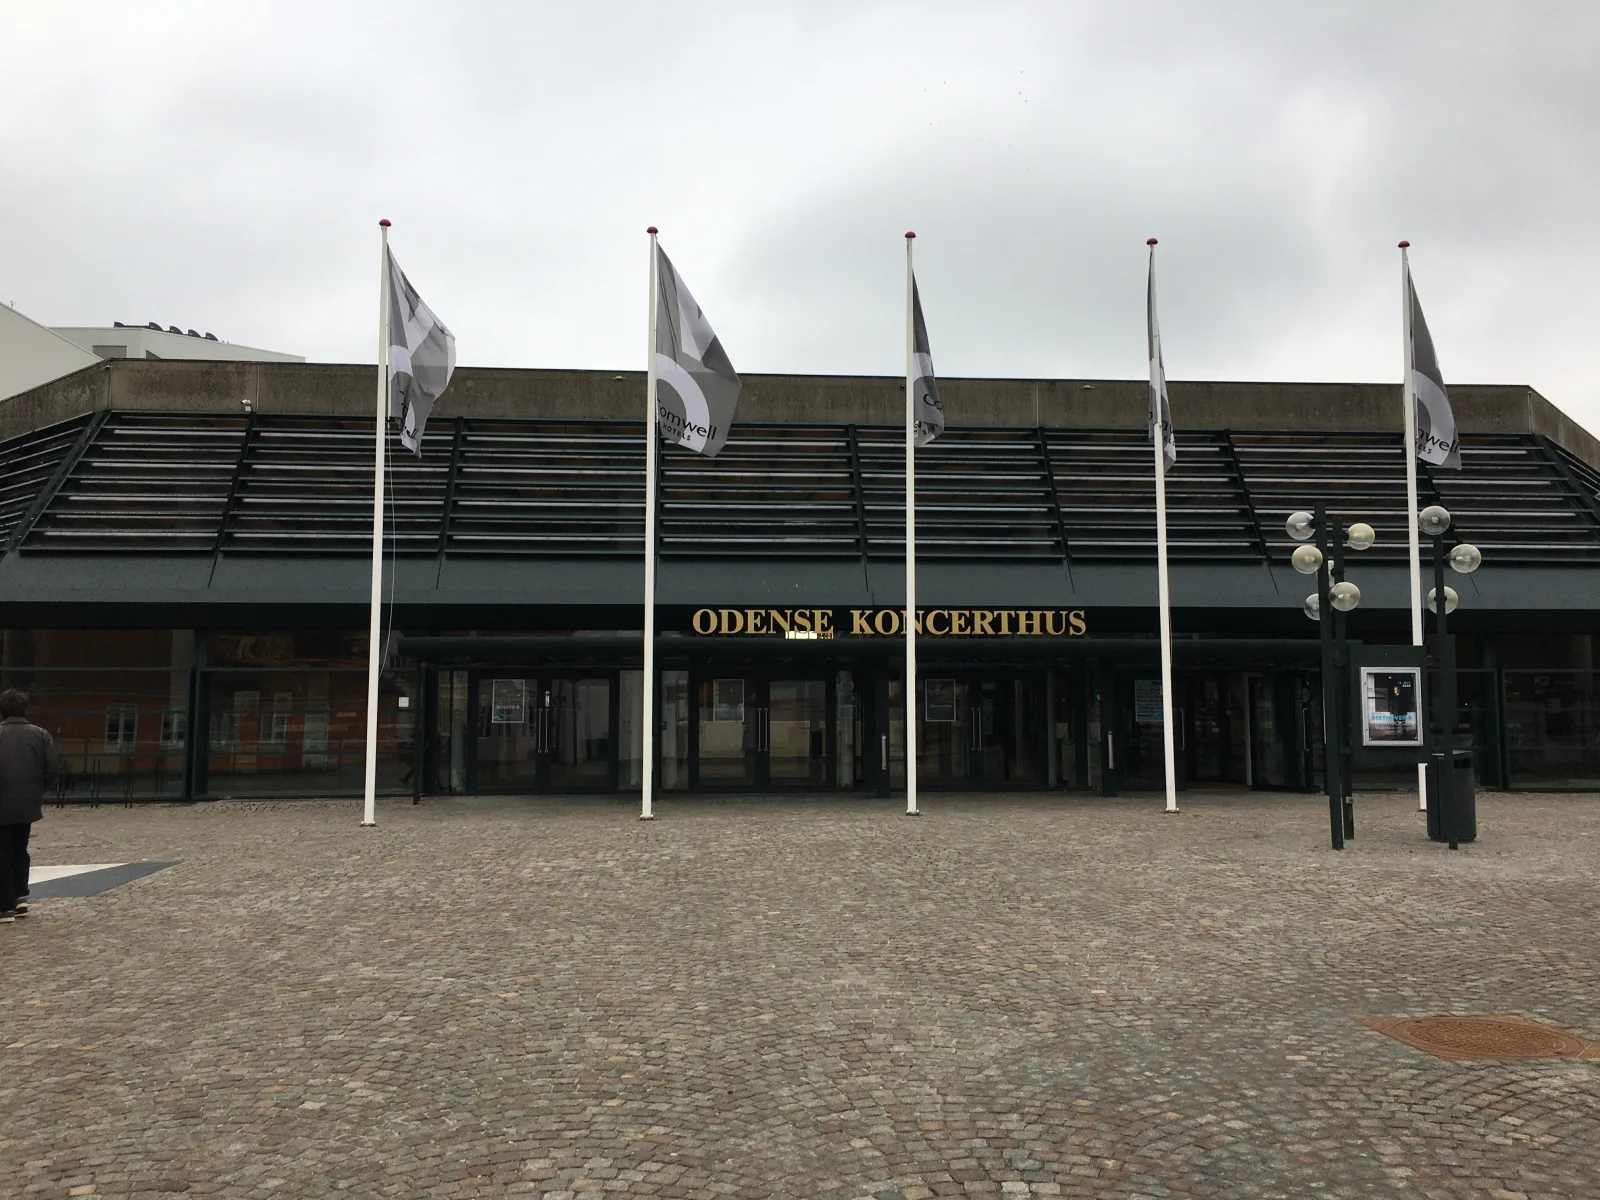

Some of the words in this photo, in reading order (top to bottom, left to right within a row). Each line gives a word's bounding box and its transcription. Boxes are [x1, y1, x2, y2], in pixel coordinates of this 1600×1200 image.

[659, 406, 717, 439] omwell
[662, 424, 691, 440] HOTELS
[692, 608, 834, 635] ODENSE
[849, 609, 1087, 636] KONCERTHUS
